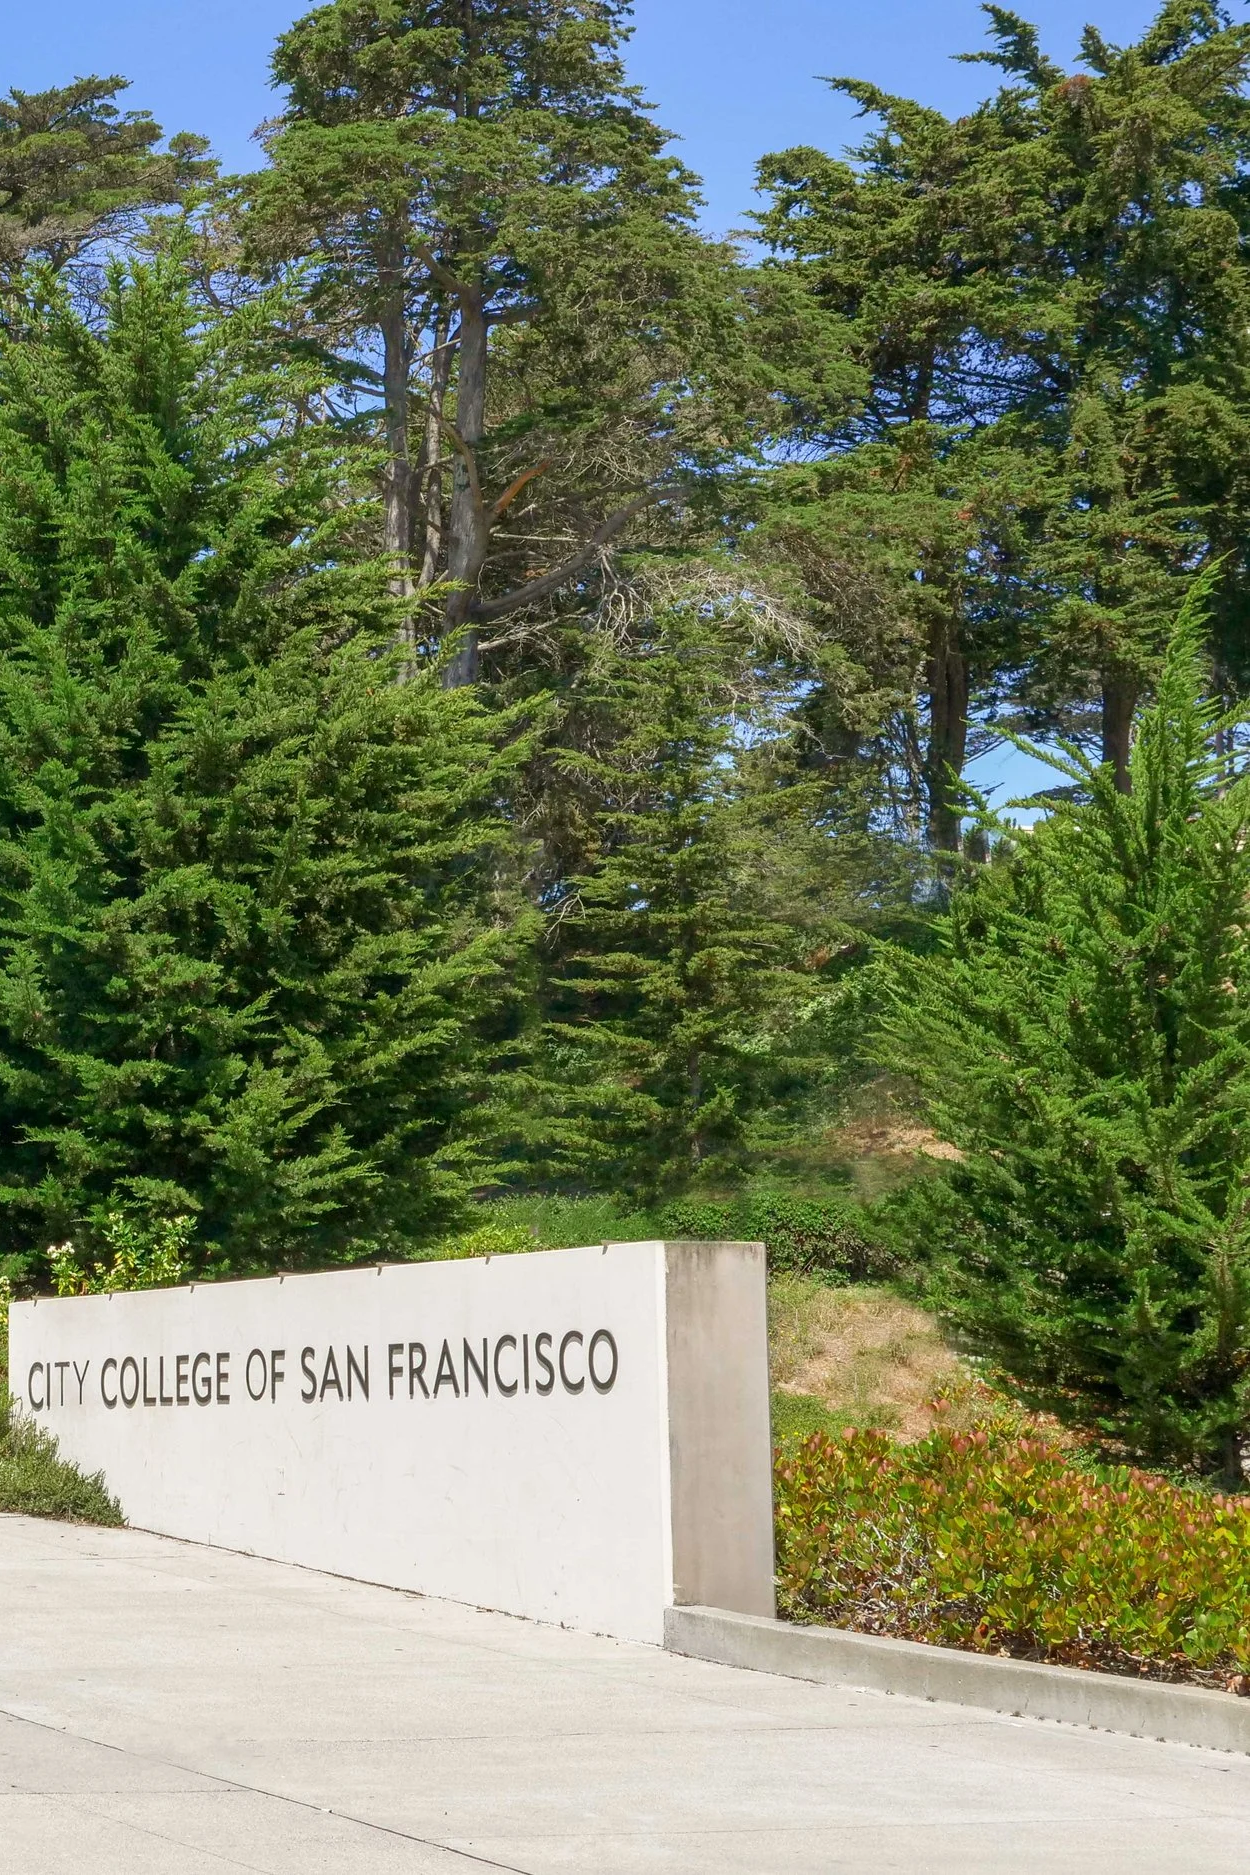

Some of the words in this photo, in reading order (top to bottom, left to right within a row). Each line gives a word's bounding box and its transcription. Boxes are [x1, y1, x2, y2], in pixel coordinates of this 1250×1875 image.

[28, 1360, 90, 1411] CITY
[100, 1351, 231, 1408] COLLEGE
[245, 1348, 287, 1402] OF
[300, 1345, 370, 1404] SAN
[387, 1328, 619, 1399] FRANCISCO
